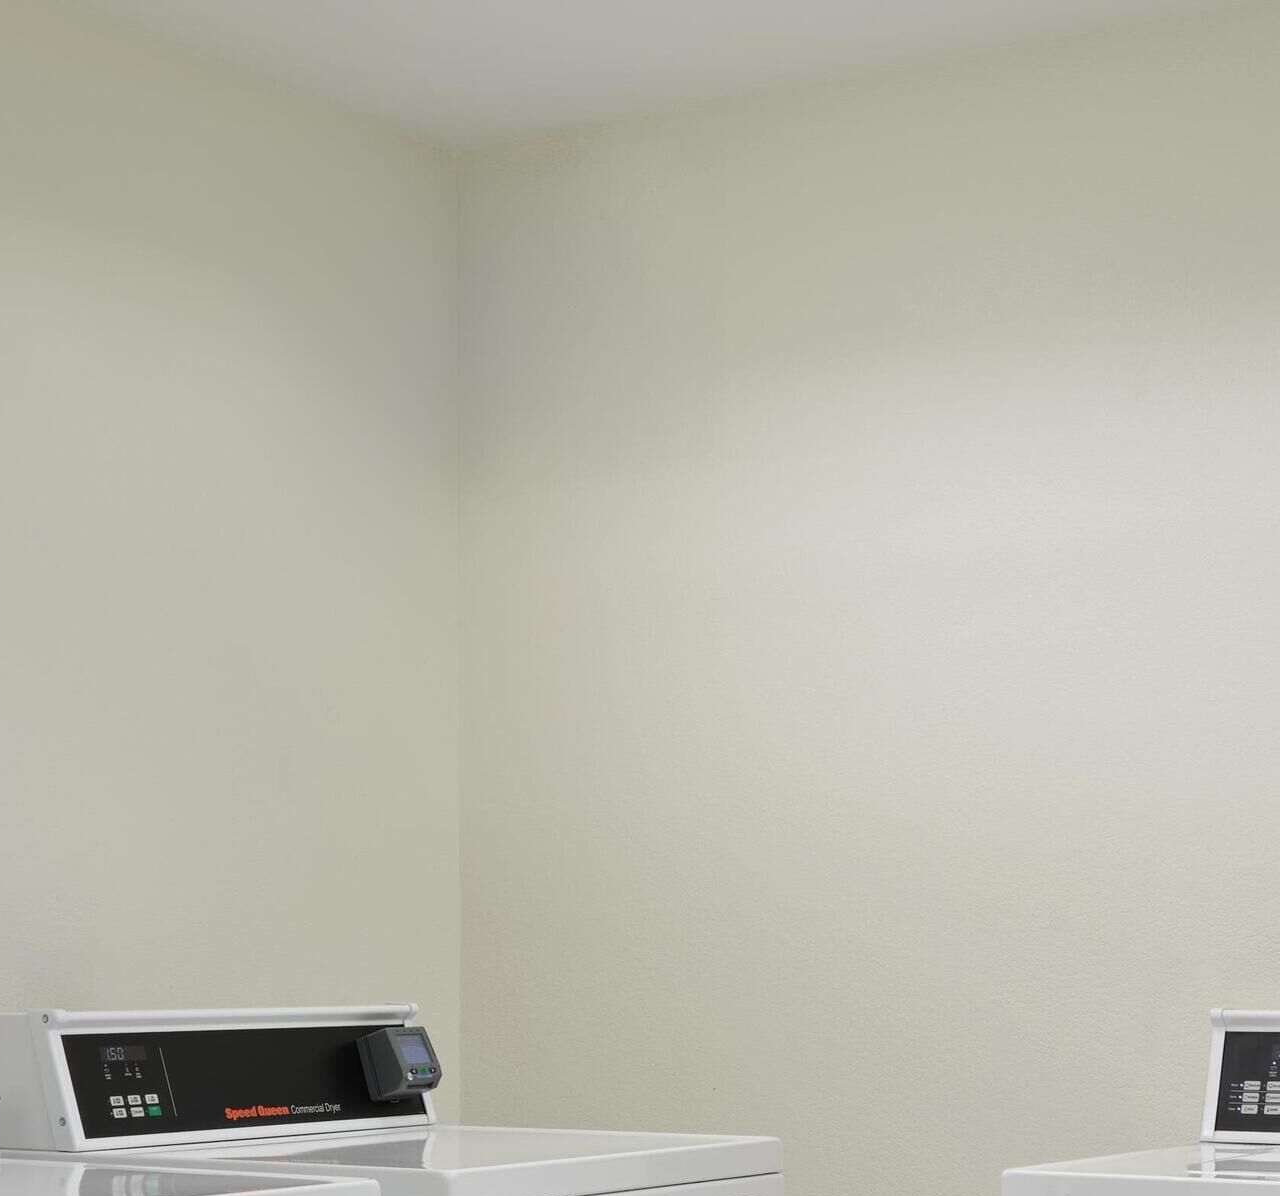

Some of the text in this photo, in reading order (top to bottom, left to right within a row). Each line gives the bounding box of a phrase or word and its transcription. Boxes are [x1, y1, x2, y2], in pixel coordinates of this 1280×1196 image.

[224, 1102, 341, 1120] Speed Queen Commercial Dryer
